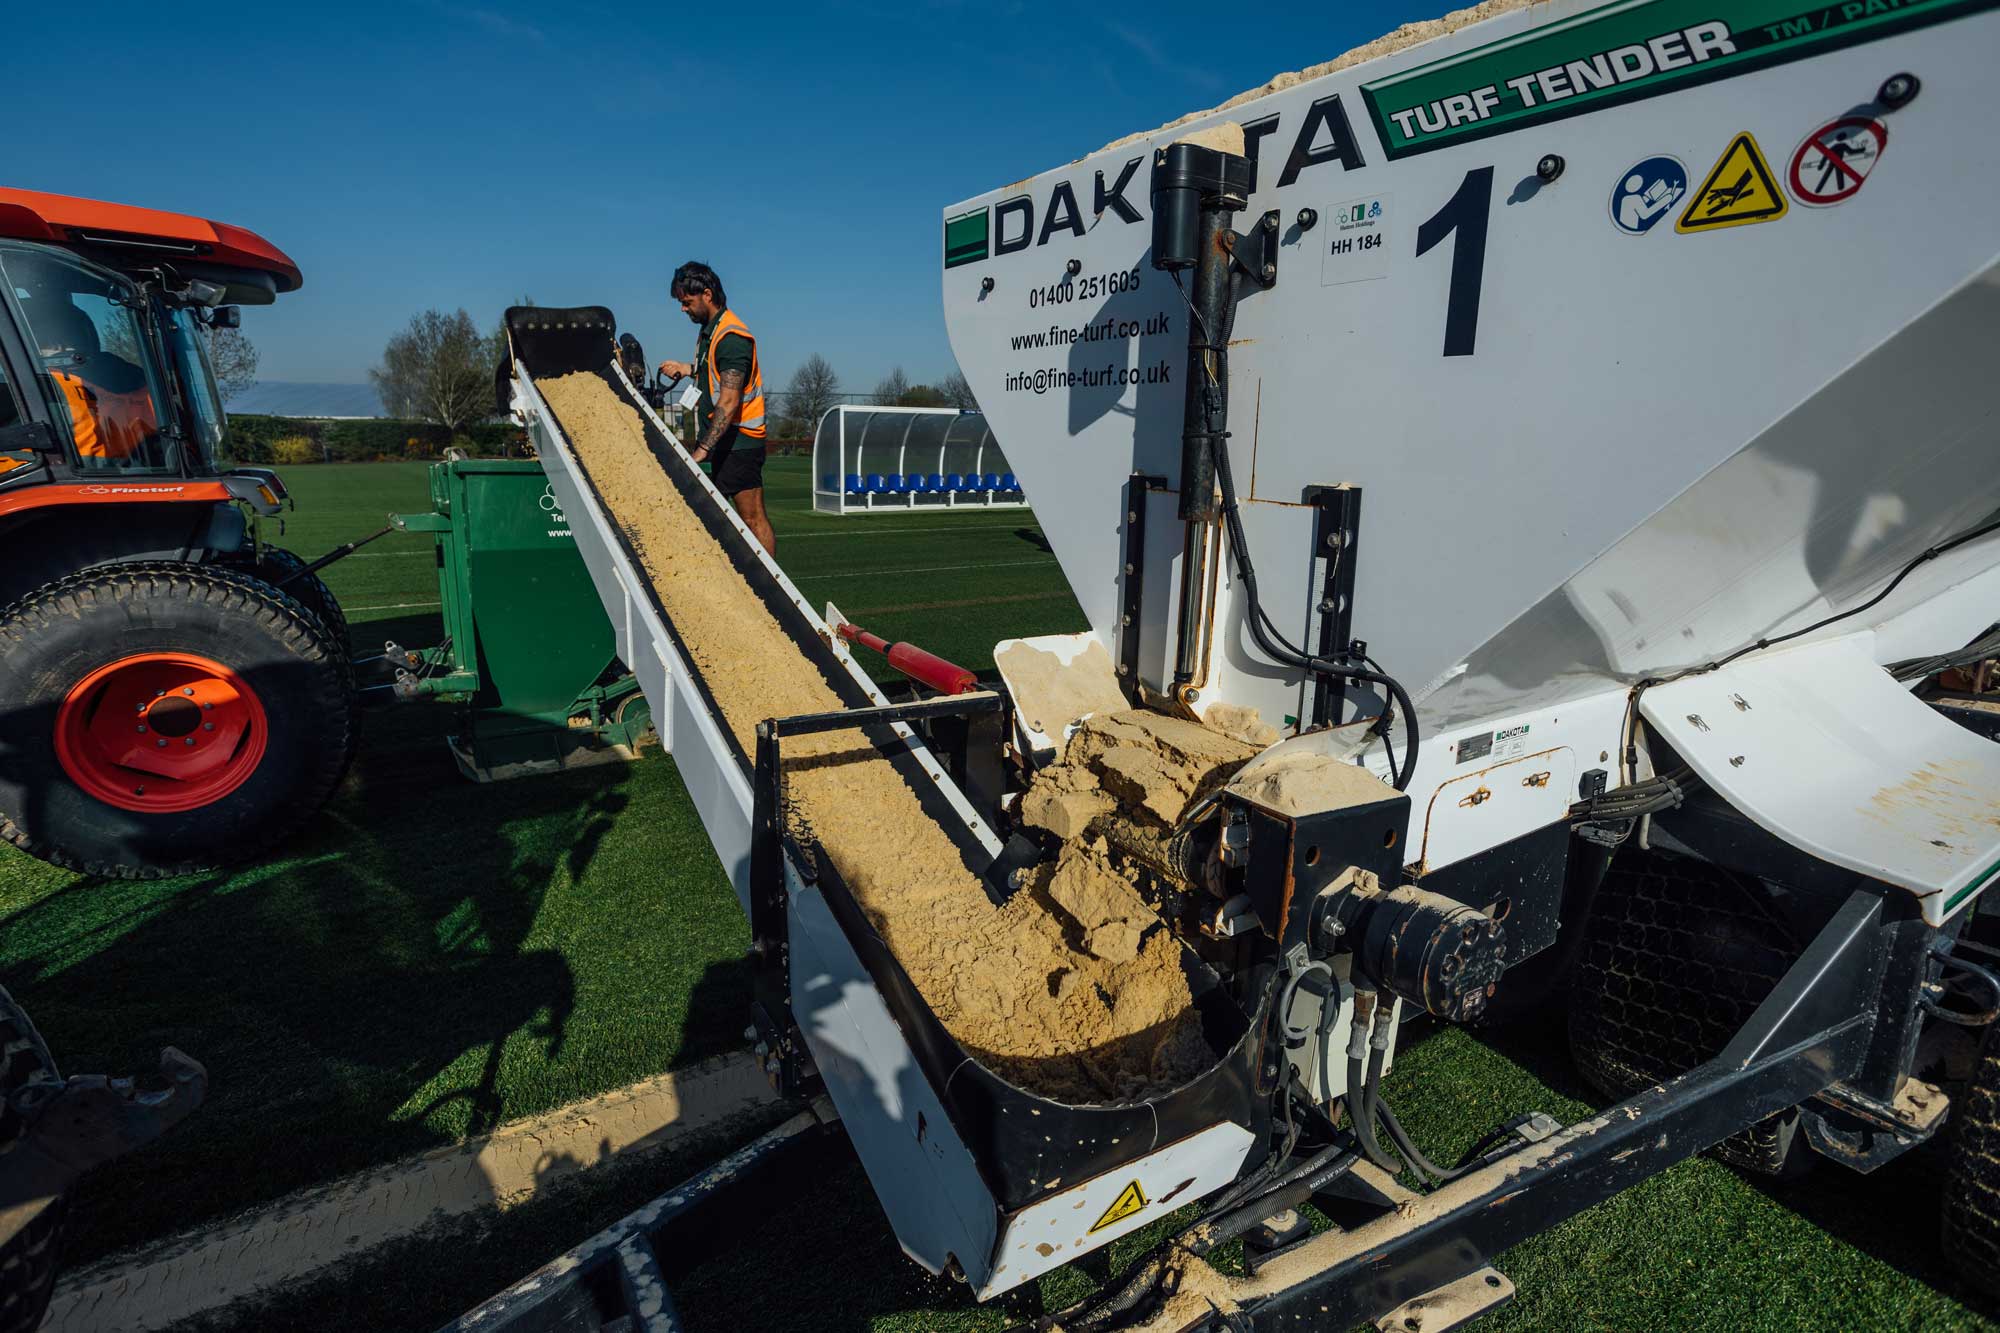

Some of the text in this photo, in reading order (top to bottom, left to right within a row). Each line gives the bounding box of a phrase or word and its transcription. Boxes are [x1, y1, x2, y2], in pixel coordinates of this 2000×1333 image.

[1389, 84, 1500, 139] TURF
[1506, 19, 1737, 108] TENDER
[1764, 14, 1812, 41] TM
[994, 93, 1367, 256] DAKTA
[1331, 233, 1382, 255] HH 184
[1416, 165, 1494, 356] 1
[1030, 268, 1140, 308] 01400 251605
[1011, 312, 1169, 350] www.fine-turf.co.uk
[1006, 360, 1170, 394] info@fine-turf.co.uk
[1501, 725, 1525, 739] DAKOTA
